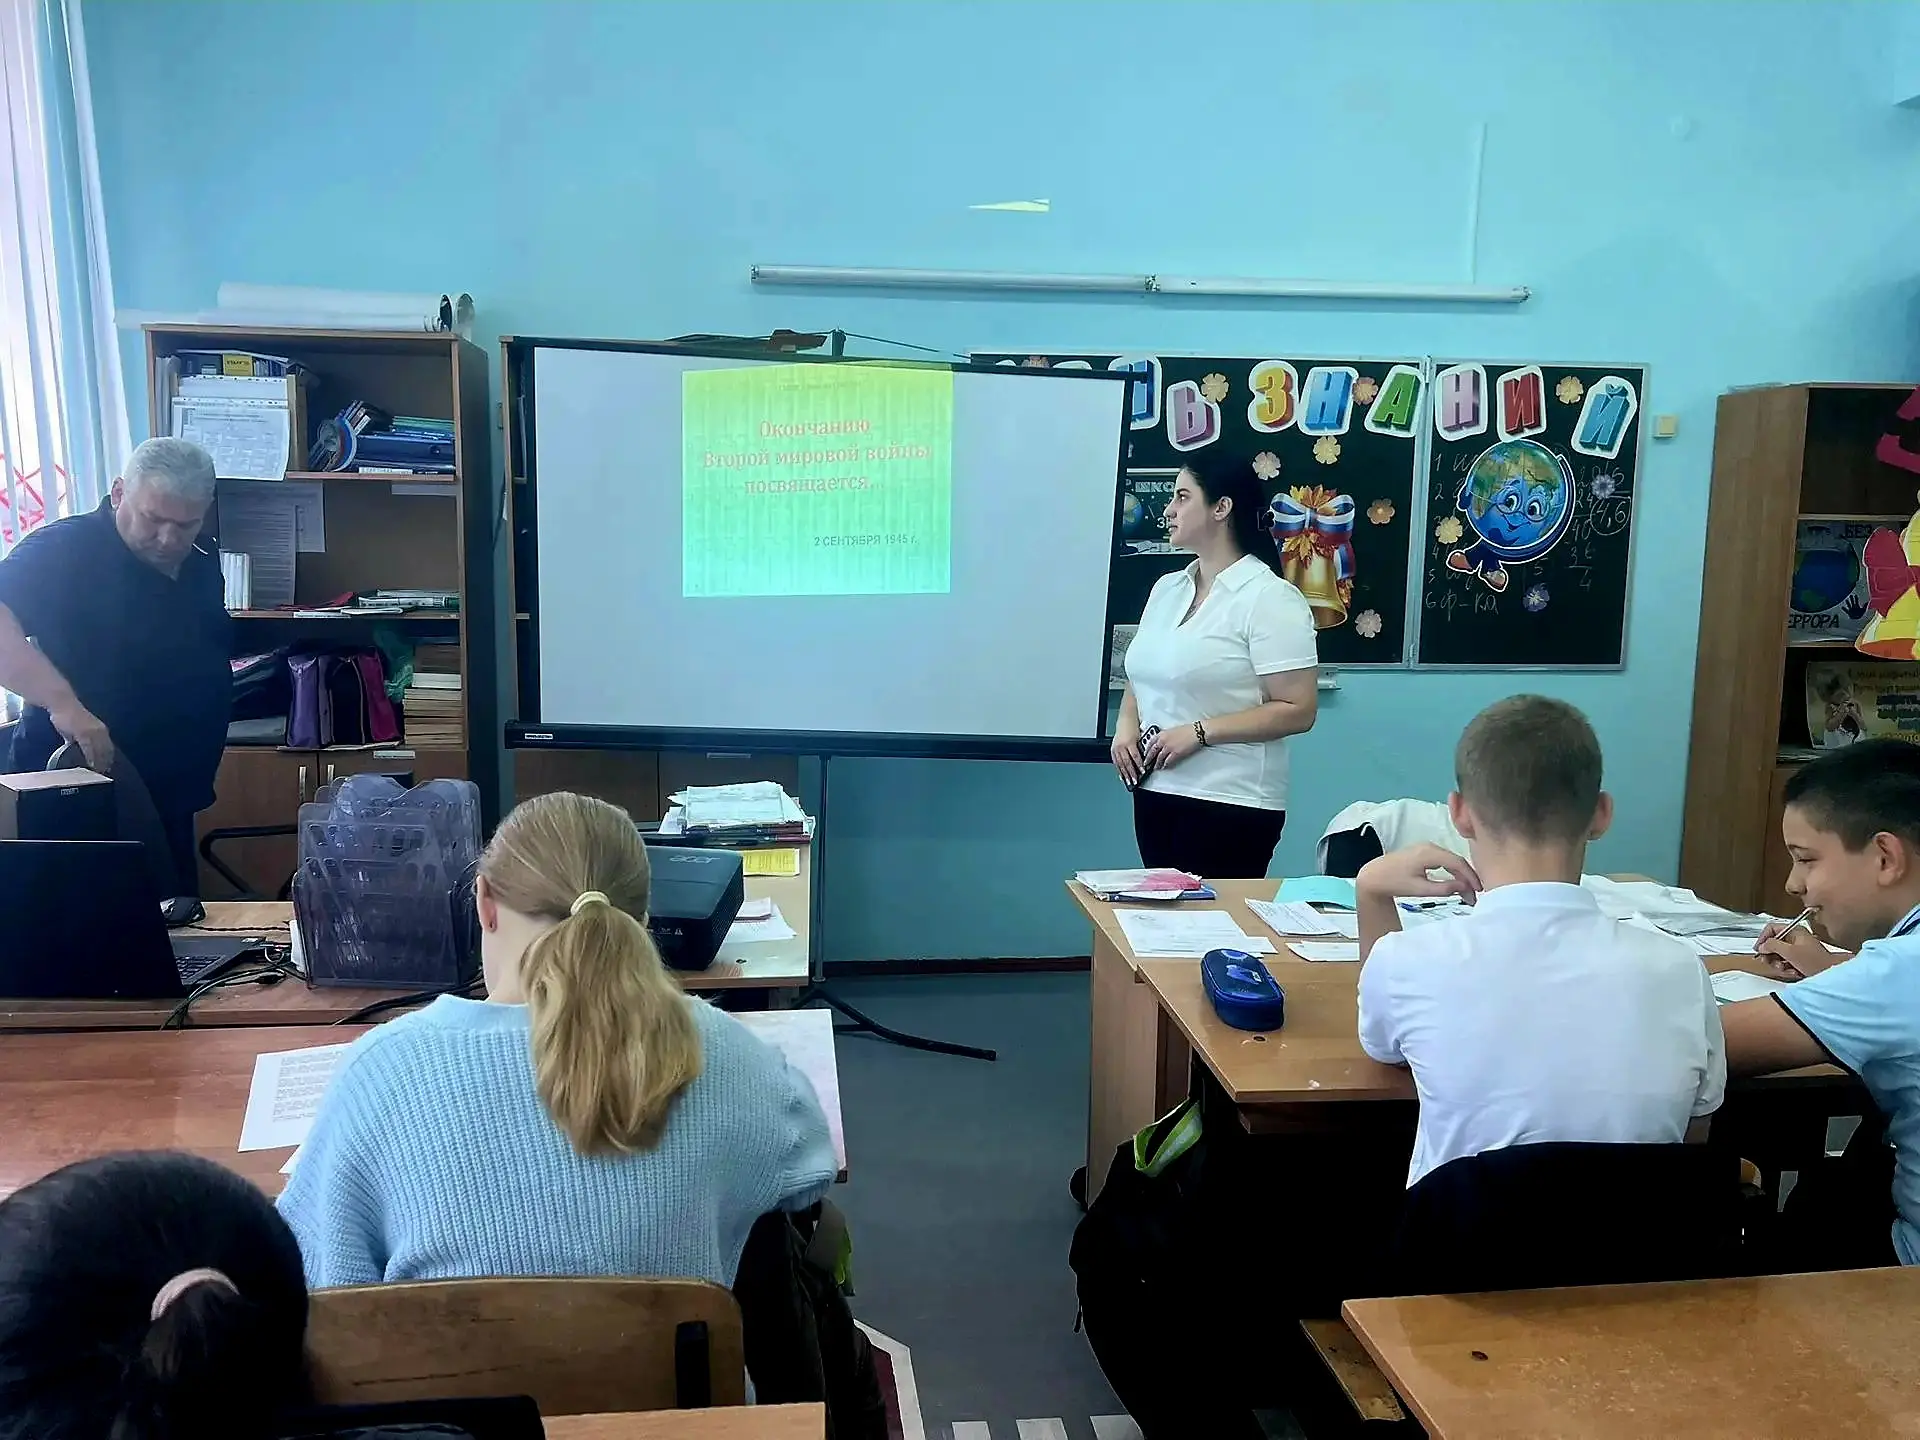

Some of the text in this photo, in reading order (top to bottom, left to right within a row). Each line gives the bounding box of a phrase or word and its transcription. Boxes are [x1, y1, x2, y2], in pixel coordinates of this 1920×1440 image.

[1254, 366, 1634, 450] ЗНАНИЙ
[759, 418, 870, 438] Окончанию
[703, 441, 932, 470] Второй мировой войны
[822, 534, 881, 547] СЕНТЯБРЯ
[884, 533, 908, 545] 1945
[1788, 614, 1840, 629] ЕРРОРА
